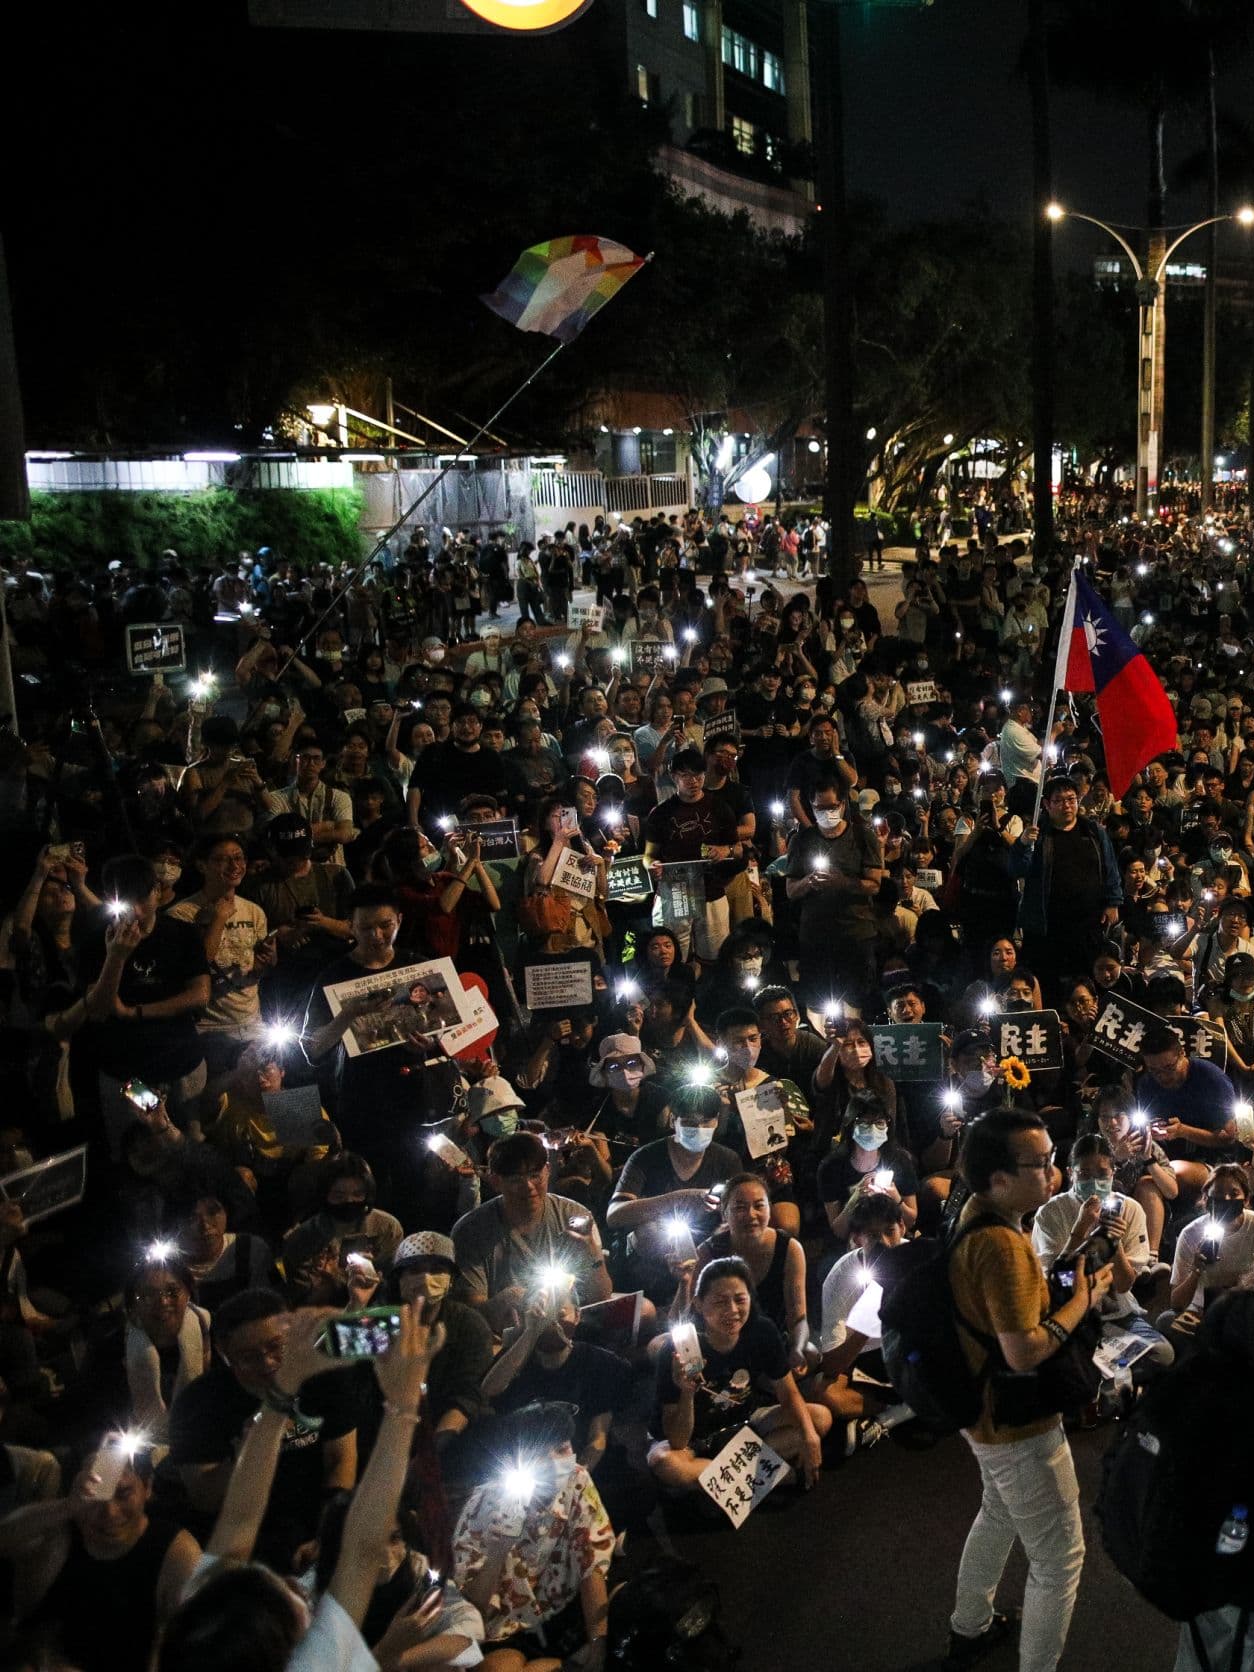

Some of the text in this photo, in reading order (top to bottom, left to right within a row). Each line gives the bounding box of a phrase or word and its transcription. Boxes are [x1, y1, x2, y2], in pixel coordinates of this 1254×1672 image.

[873, 1033, 927, 1066] 民主
[1001, 1022, 1047, 1057] 民主
[1095, 1002, 1147, 1053] 民主
[707, 1441, 762, 1500] 沒有討論
[725, 1459, 781, 1515] 不是民主
